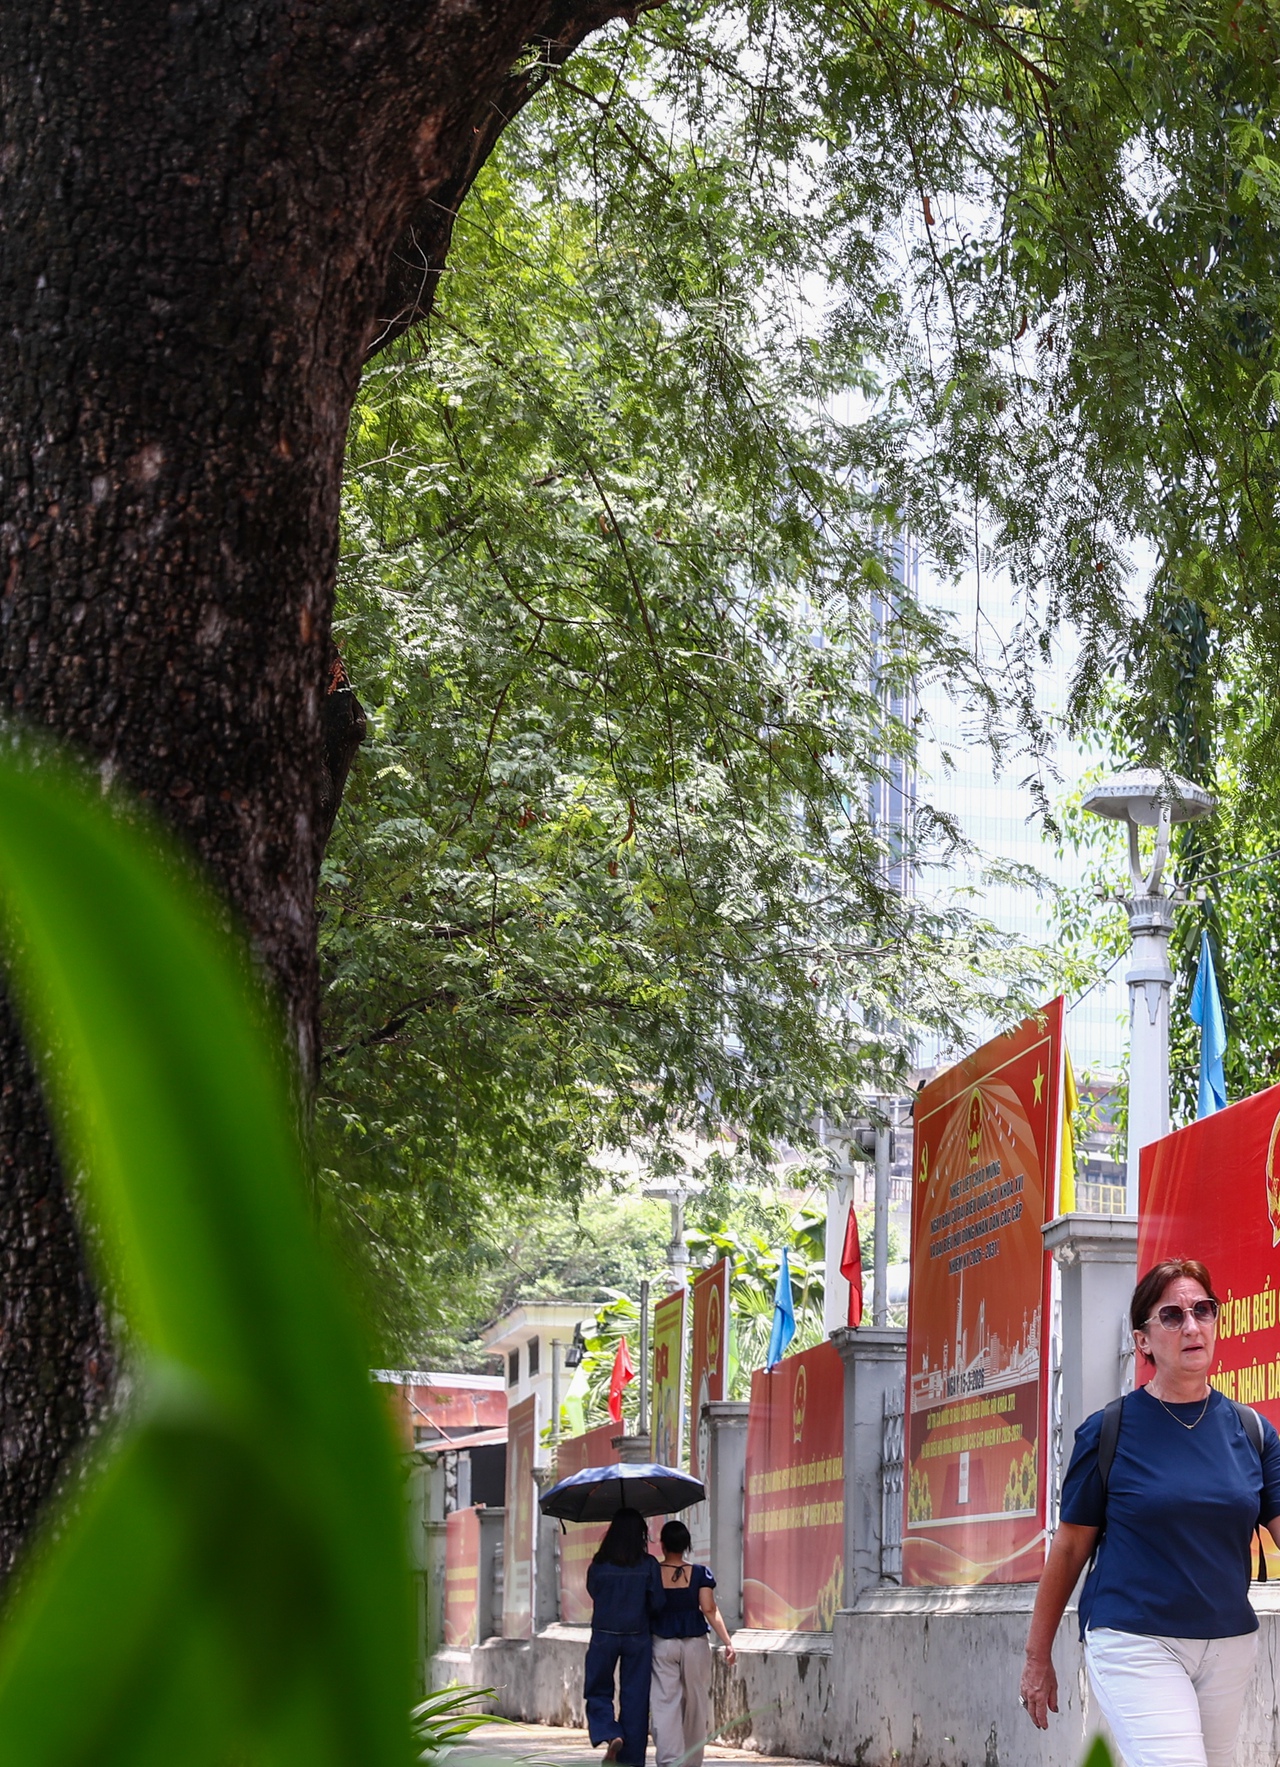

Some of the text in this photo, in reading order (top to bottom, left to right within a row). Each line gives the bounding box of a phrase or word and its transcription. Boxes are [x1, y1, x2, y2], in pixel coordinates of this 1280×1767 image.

[1219, 1289, 1233, 1340] CỬ
[1234, 1296, 1250, 1343] ĐẠI
[1252, 1274, 1277, 1332] BIỂU
[1237, 1357, 1266, 1404] NHÂN
